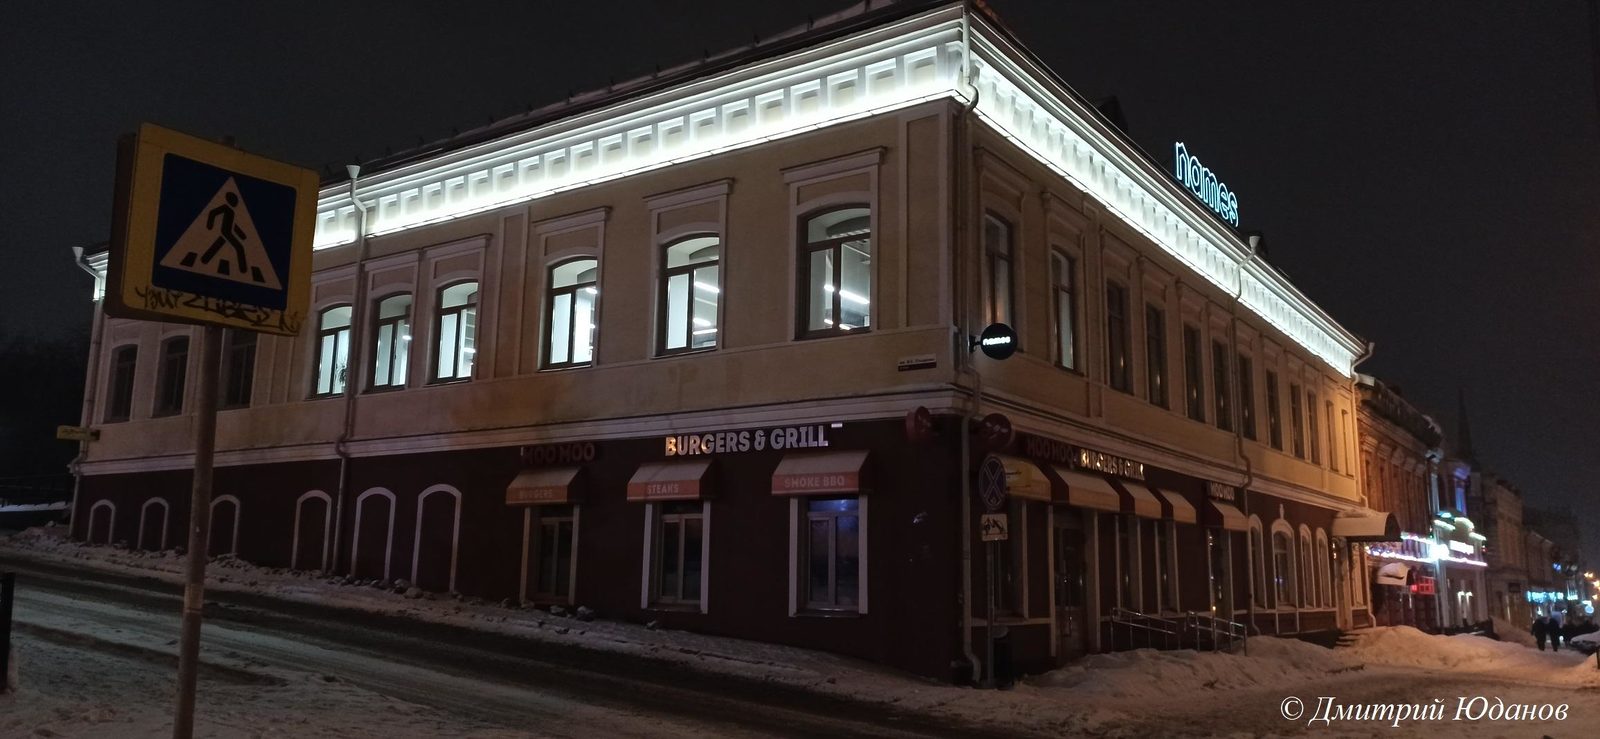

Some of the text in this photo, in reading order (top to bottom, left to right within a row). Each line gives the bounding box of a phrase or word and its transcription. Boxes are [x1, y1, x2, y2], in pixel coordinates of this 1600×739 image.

[1176, 142, 1239, 227] names
[665, 425, 829, 456] BURGERS & GRILL
[559, 443, 596, 462] MOO
[1081, 448, 1118, 474] BURGERS
[647, 484, 679, 495] STEAKS
[784, 475, 845, 489] SMOKE BBQ
